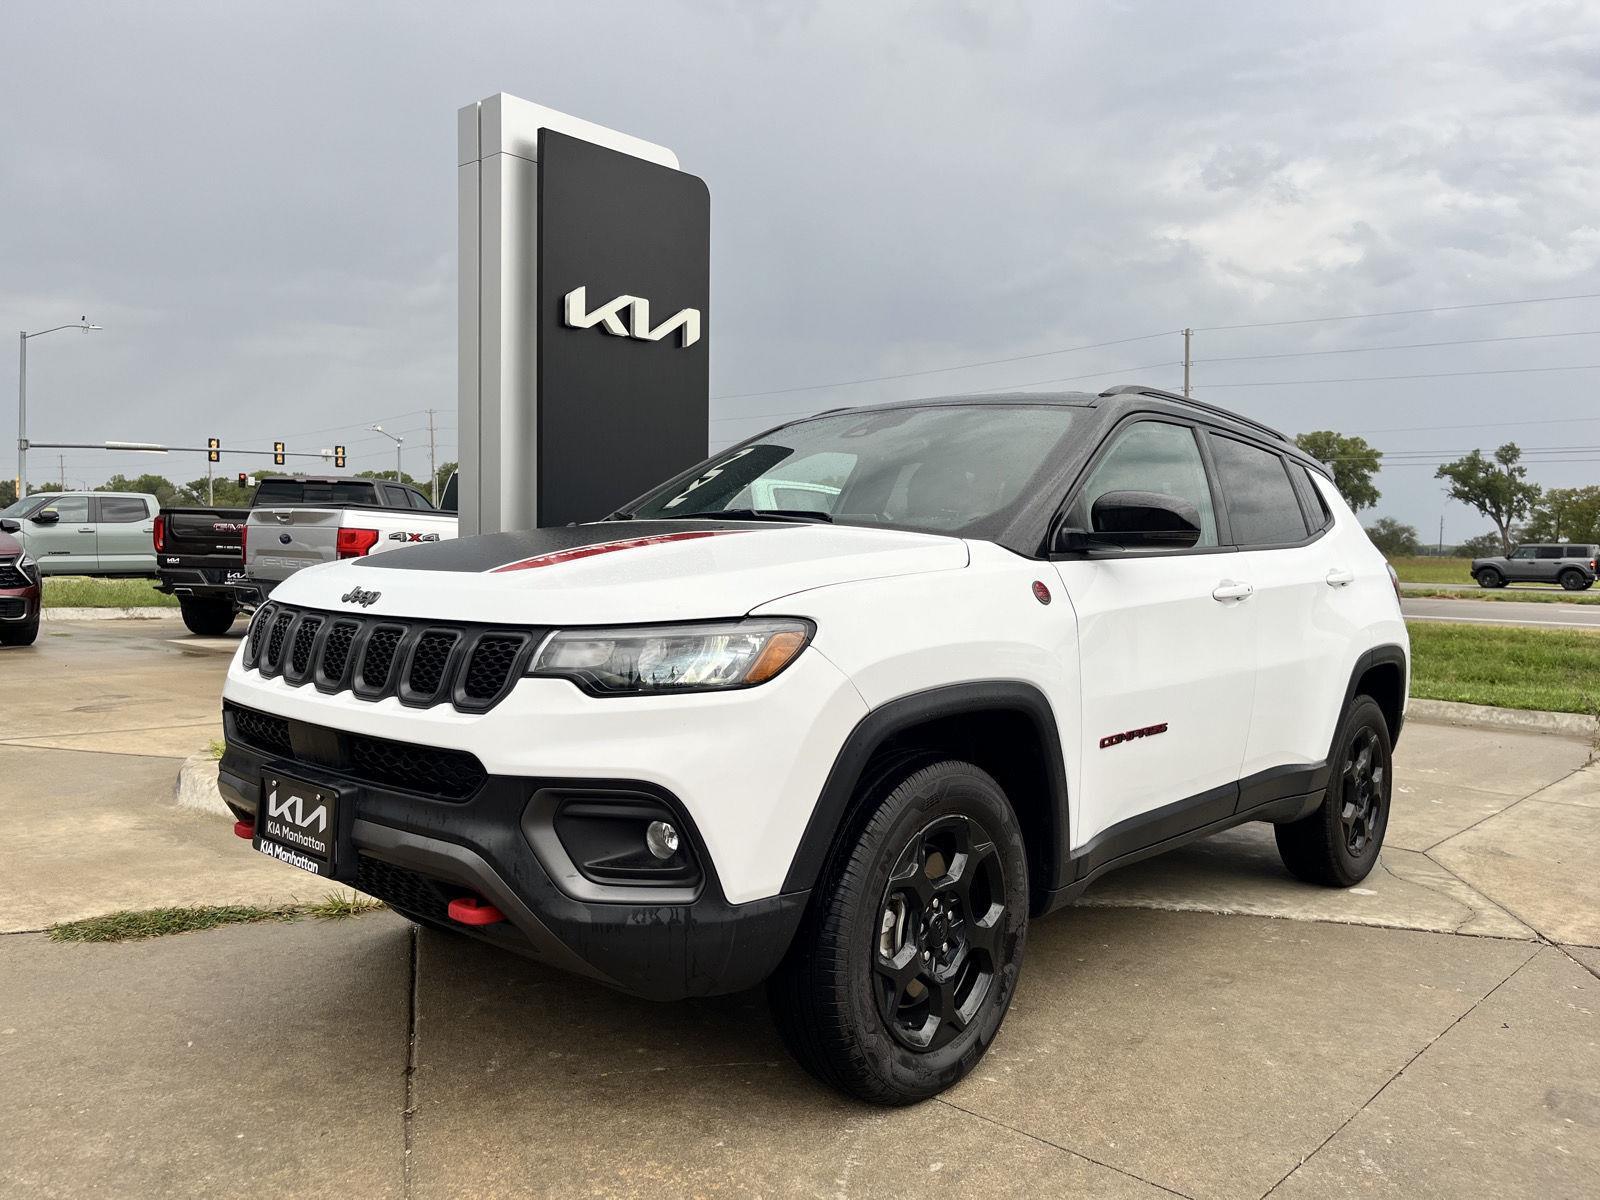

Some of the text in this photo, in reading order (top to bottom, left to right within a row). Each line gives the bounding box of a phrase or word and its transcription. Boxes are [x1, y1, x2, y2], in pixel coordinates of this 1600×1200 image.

[565, 285, 701, 348] KIA
[213, 522, 247, 532] GM
[341, 585, 382, 608] Jeep
[1099, 722, 1169, 749] COMPASS
[269, 790, 327, 833] KIA
[268, 821, 326, 853] KIA Manhattan
[260, 840, 319, 874] KIA Manhattan
